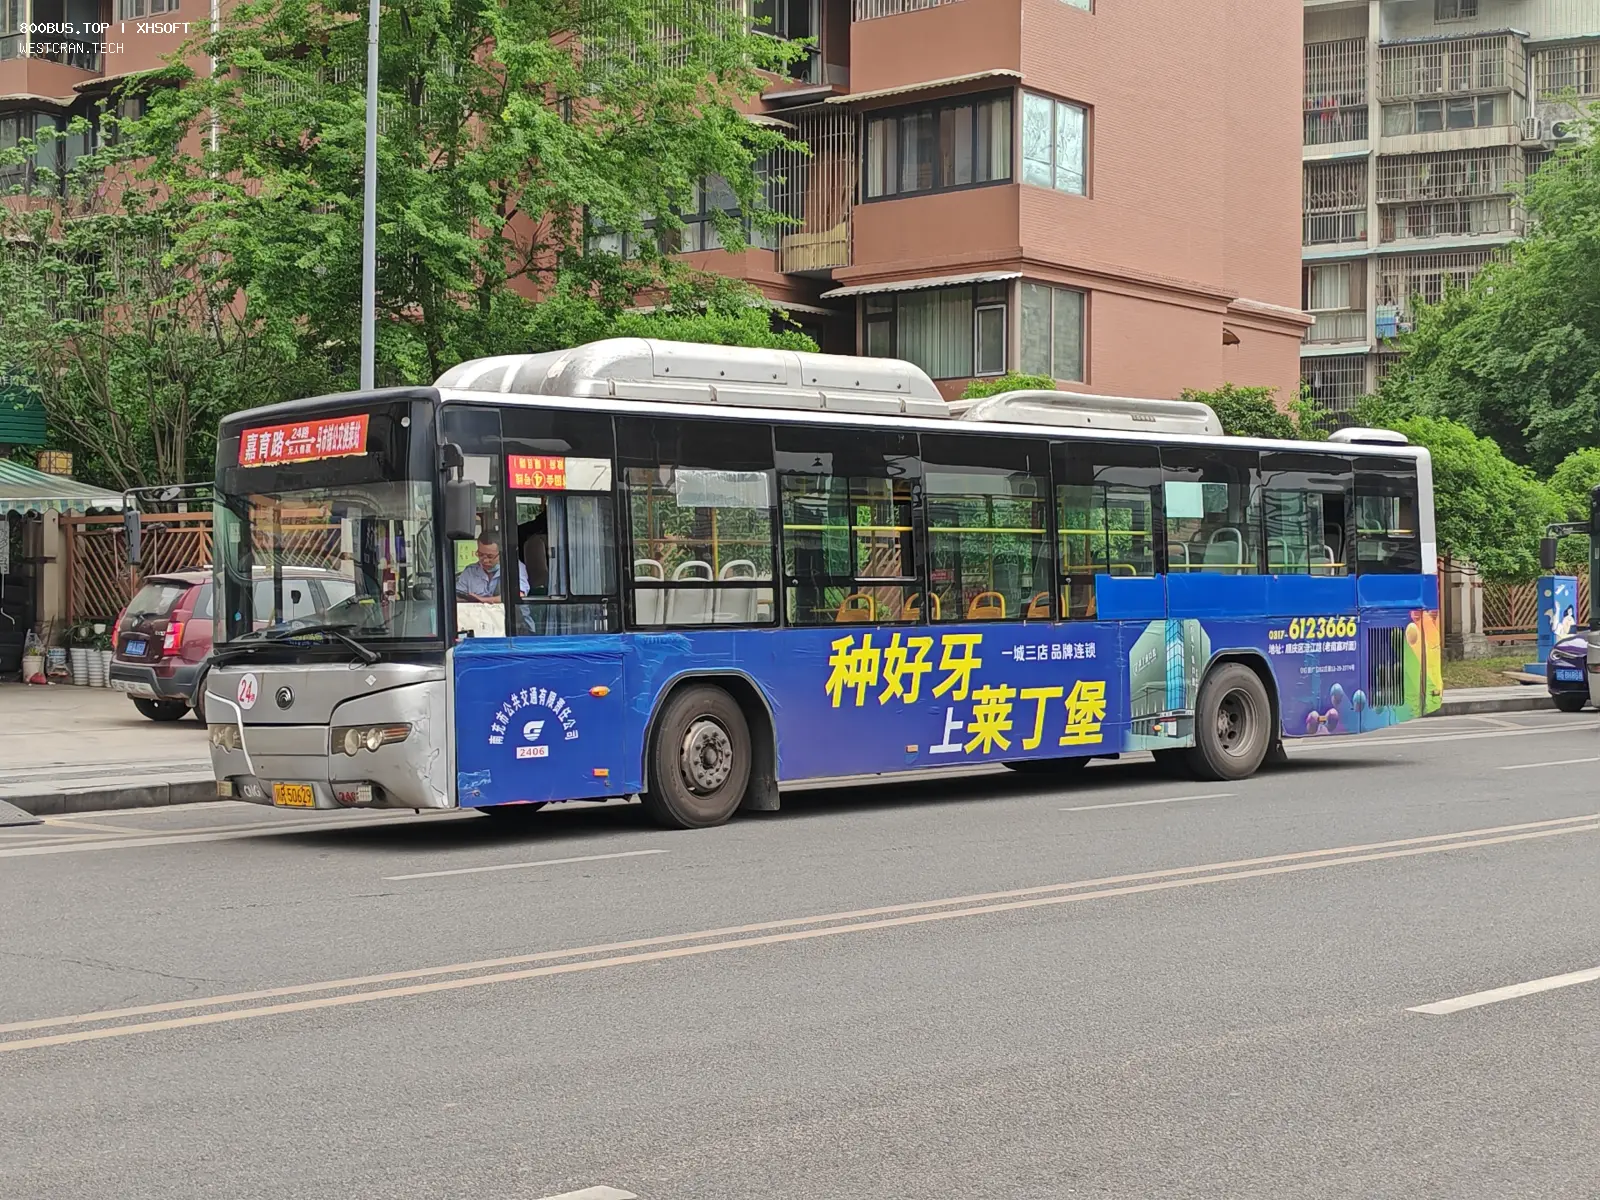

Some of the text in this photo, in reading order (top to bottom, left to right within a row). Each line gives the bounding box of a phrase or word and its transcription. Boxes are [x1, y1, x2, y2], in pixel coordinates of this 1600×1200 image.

[244, 429, 286, 461] 嘉育路
[1001, 641, 1097, 662] 一城三店 品牌连锁
[825, 632, 983, 708] 种好牙
[488, 686, 579, 745] 南充市公共交通有限责任公司
[519, 746, 546, 757] 2406
